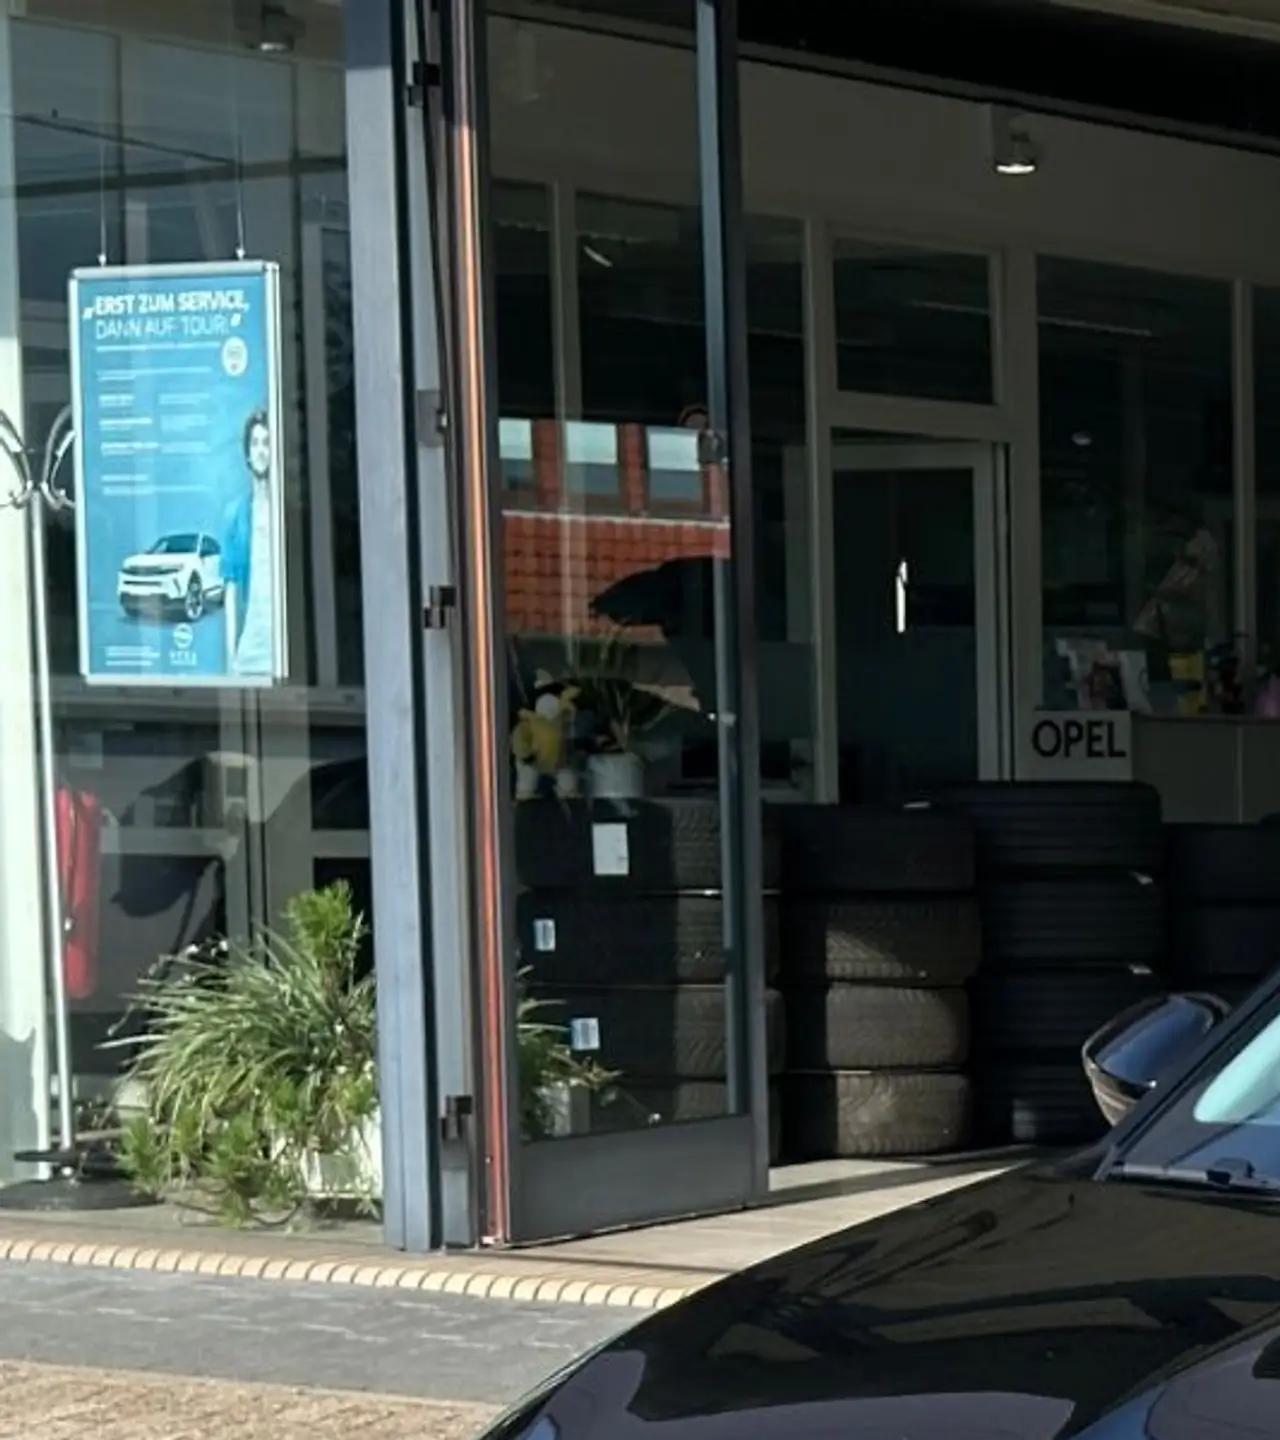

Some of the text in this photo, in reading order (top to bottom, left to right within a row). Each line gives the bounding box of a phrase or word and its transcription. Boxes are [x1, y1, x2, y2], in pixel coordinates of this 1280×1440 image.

[138, 293, 174, 313] ZUM
[96, 316, 141, 340] DANN
[144, 314, 179, 336] AUF
[1032, 720, 1127, 758] OPEL
